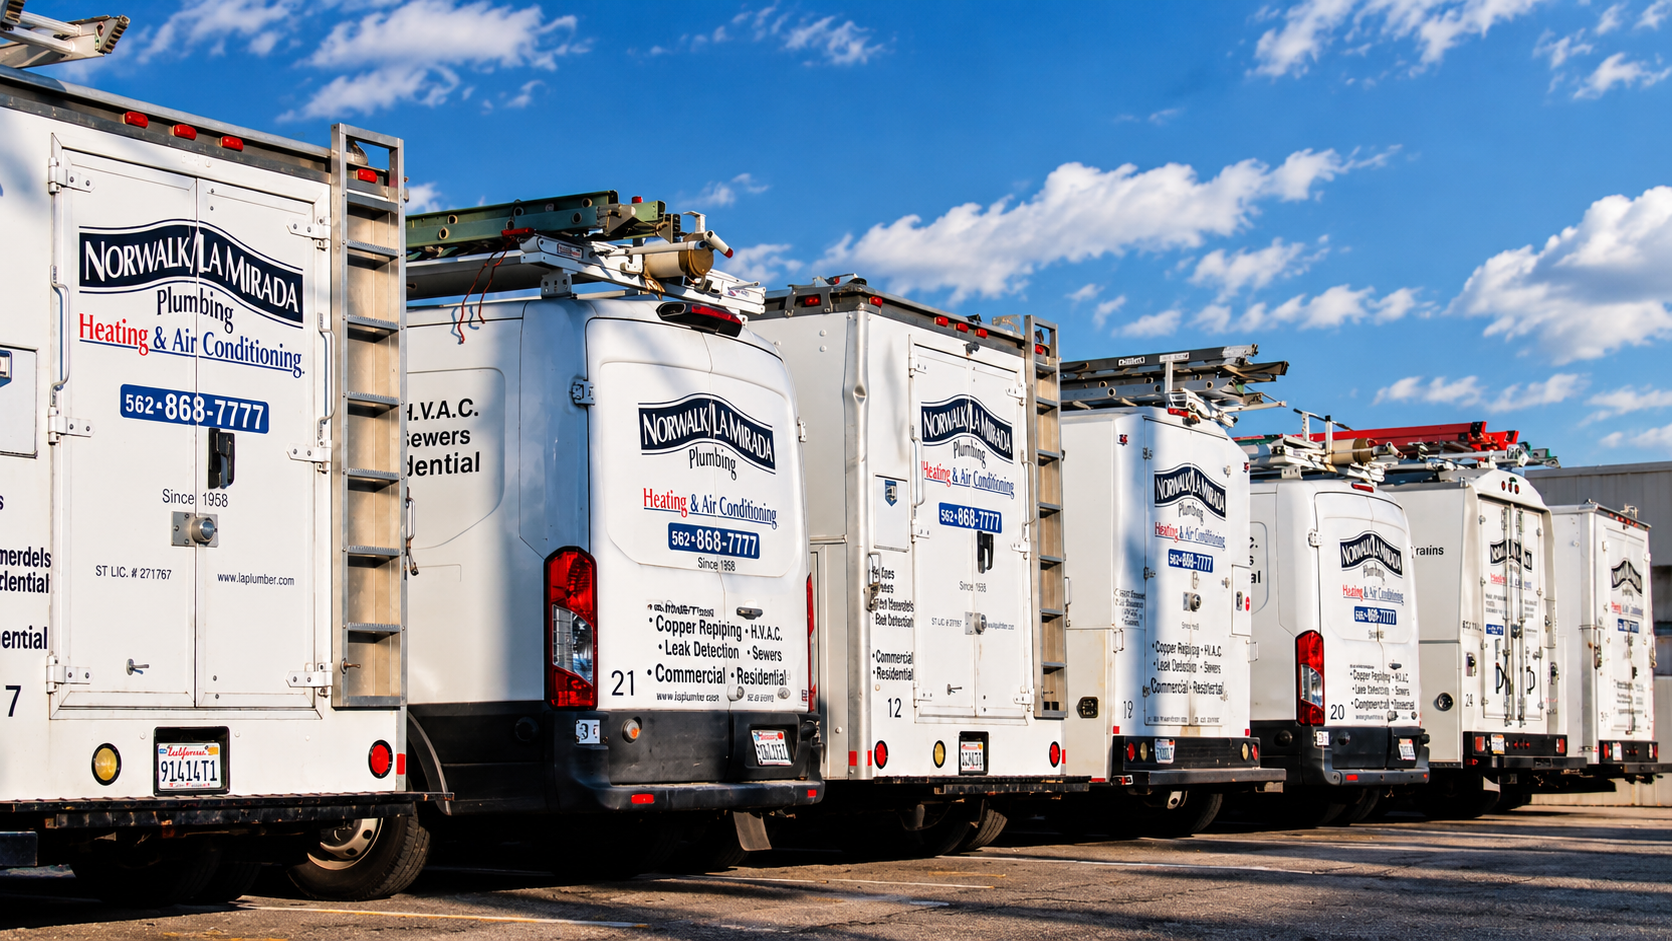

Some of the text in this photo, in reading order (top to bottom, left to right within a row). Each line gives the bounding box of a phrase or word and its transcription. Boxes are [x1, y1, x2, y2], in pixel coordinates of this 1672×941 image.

[226, 246, 299, 313] MIRADA
[157, 287, 234, 334] Plumbing
[80, 313, 149, 356] Heating
[153, 326, 167, 350] &
[172, 327, 197, 353] Air
[730, 425, 773, 463] MIRADA
[953, 439, 986, 469] Plumbing
[688, 447, 737, 480] Plumbing
[922, 461, 951, 487] Heating
[952, 467, 958, 482] &
[960, 469, 971, 485] Air
[162, 489, 228, 508] Since 1958
[643, 488, 687, 518] Heating
[690, 494, 699, 512] &
[702, 494, 717, 514] Air
[95, 565, 108, 577] ST
[111, 566, 128, 578] LIC.
[140, 568, 172, 580] 271767
[697, 557, 718, 570] Since
[217, 572, 295, 586] www.laplumber.com
[656, 615, 783, 642] Copper Repiping H.V.A.C.
[665, 640, 783, 661] Leak Detection Sewers
[876, 650, 914, 664] Commercial
[611, 670, 635, 696] 21
[655, 664, 787, 686] Commercial Residential
[877, 666, 914, 681] Residential
[5, 685, 21, 717] 7
[887, 698, 902, 718] 12
[1330, 704, 1345, 720] 20
[161, 760, 218, 782] 91414T1
